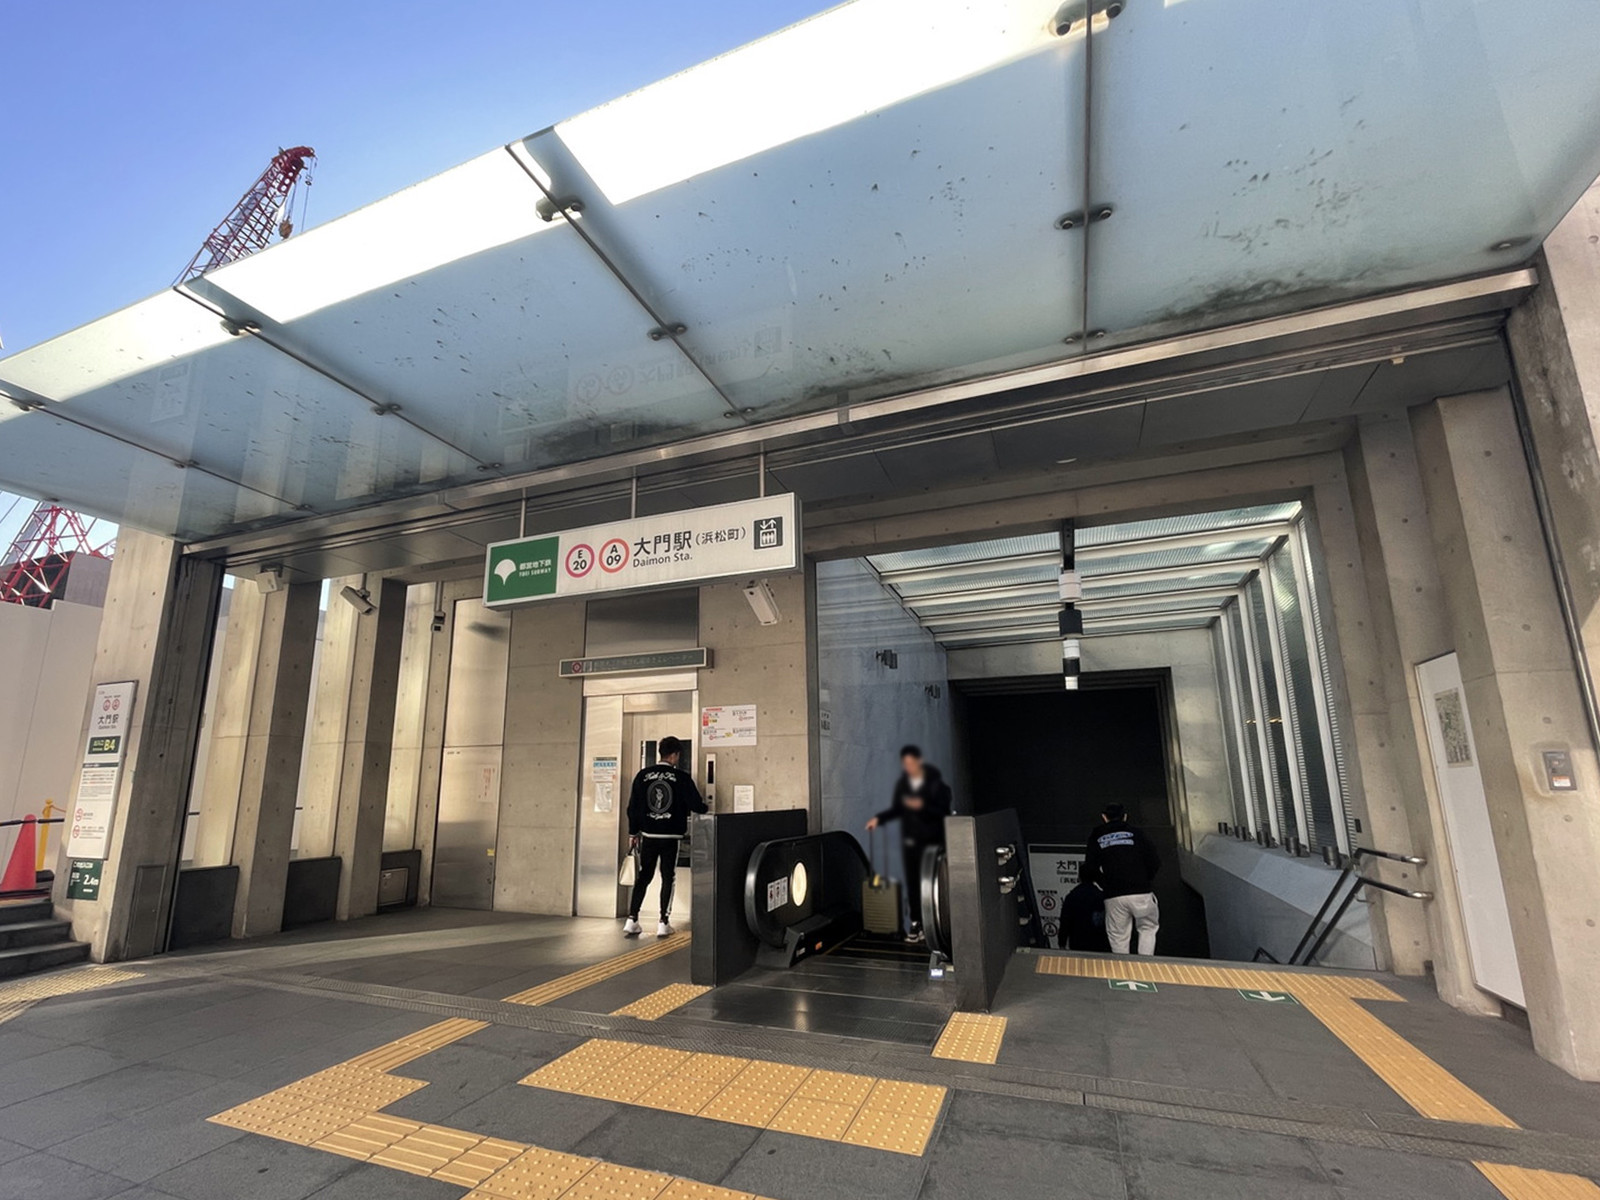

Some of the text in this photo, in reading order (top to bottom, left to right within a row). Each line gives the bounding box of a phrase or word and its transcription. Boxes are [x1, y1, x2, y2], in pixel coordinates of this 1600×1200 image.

[610, 544, 618, 554] A
[633, 530, 692, 557] 大門駅
[577, 549, 583, 559] E
[606, 554, 621, 566] 09
[633, 552, 693, 568] Daimon Sta.
[573, 559, 587, 571] 20
